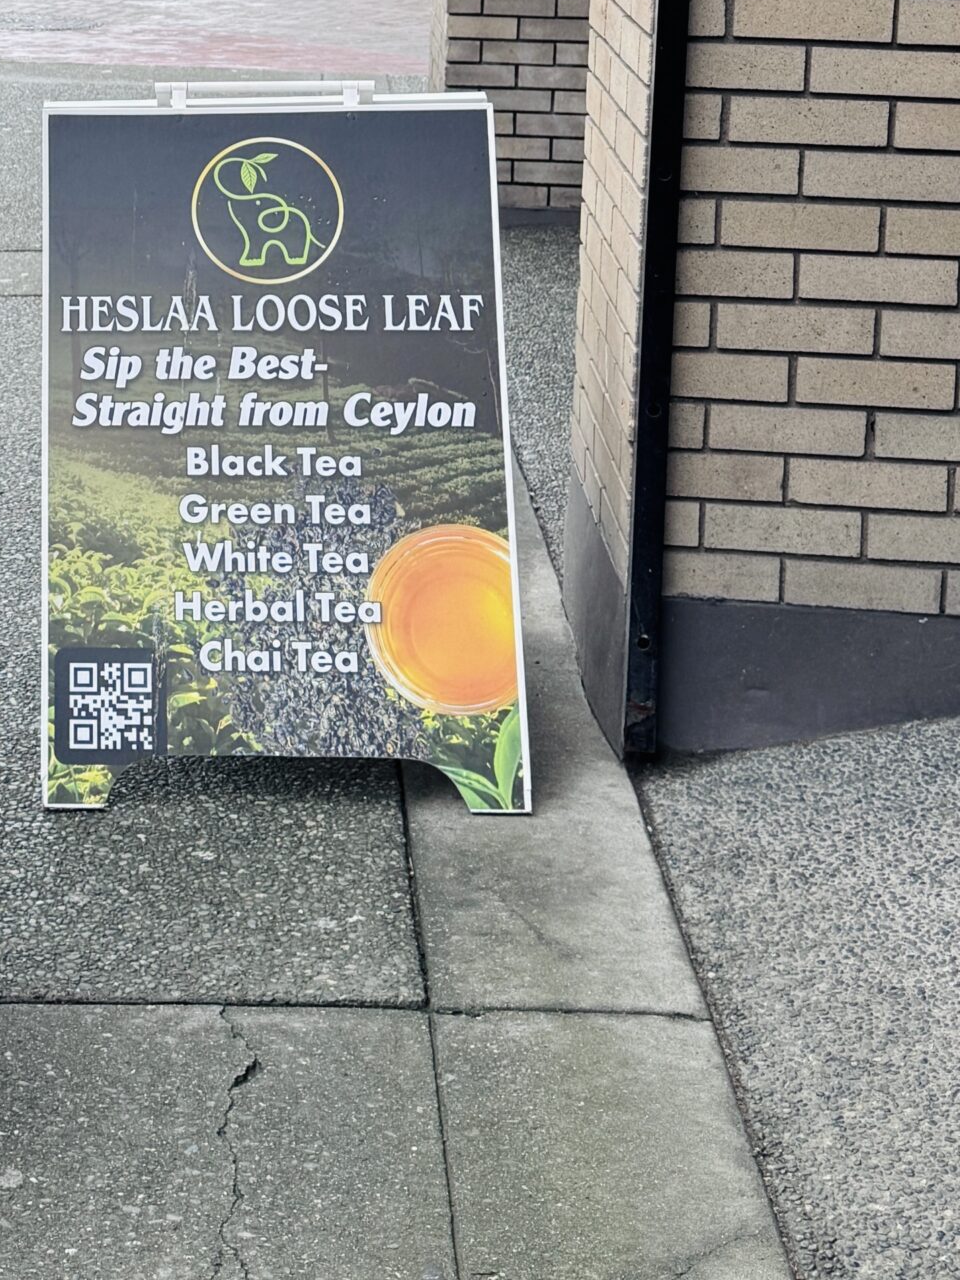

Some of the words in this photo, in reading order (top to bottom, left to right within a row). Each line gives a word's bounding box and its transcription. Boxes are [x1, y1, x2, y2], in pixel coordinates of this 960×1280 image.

[61, 294, 219, 332] HESLAA
[231, 294, 369, 332] LOOSE
[382, 294, 484, 332] LEAF
[80, 346, 142, 388] Sip
[155, 346, 216, 380] the
[228, 346, 328, 380] Best-
[71, 392, 226, 435] Straight
[233, 392, 329, 427] from
[343, 392, 476, 435] Ceylon
[186, 445, 288, 476] Black
[297, 447, 361, 476] Tea
[179, 494, 295, 524] Green
[305, 495, 370, 525] Tea
[182, 540, 293, 572] White
[302, 543, 368, 573] Tea
[175, 589, 304, 622] Herbal
[315, 592, 382, 623] Tea
[199, 638, 280, 671] Chai
[292, 641, 358, 672] Tea
